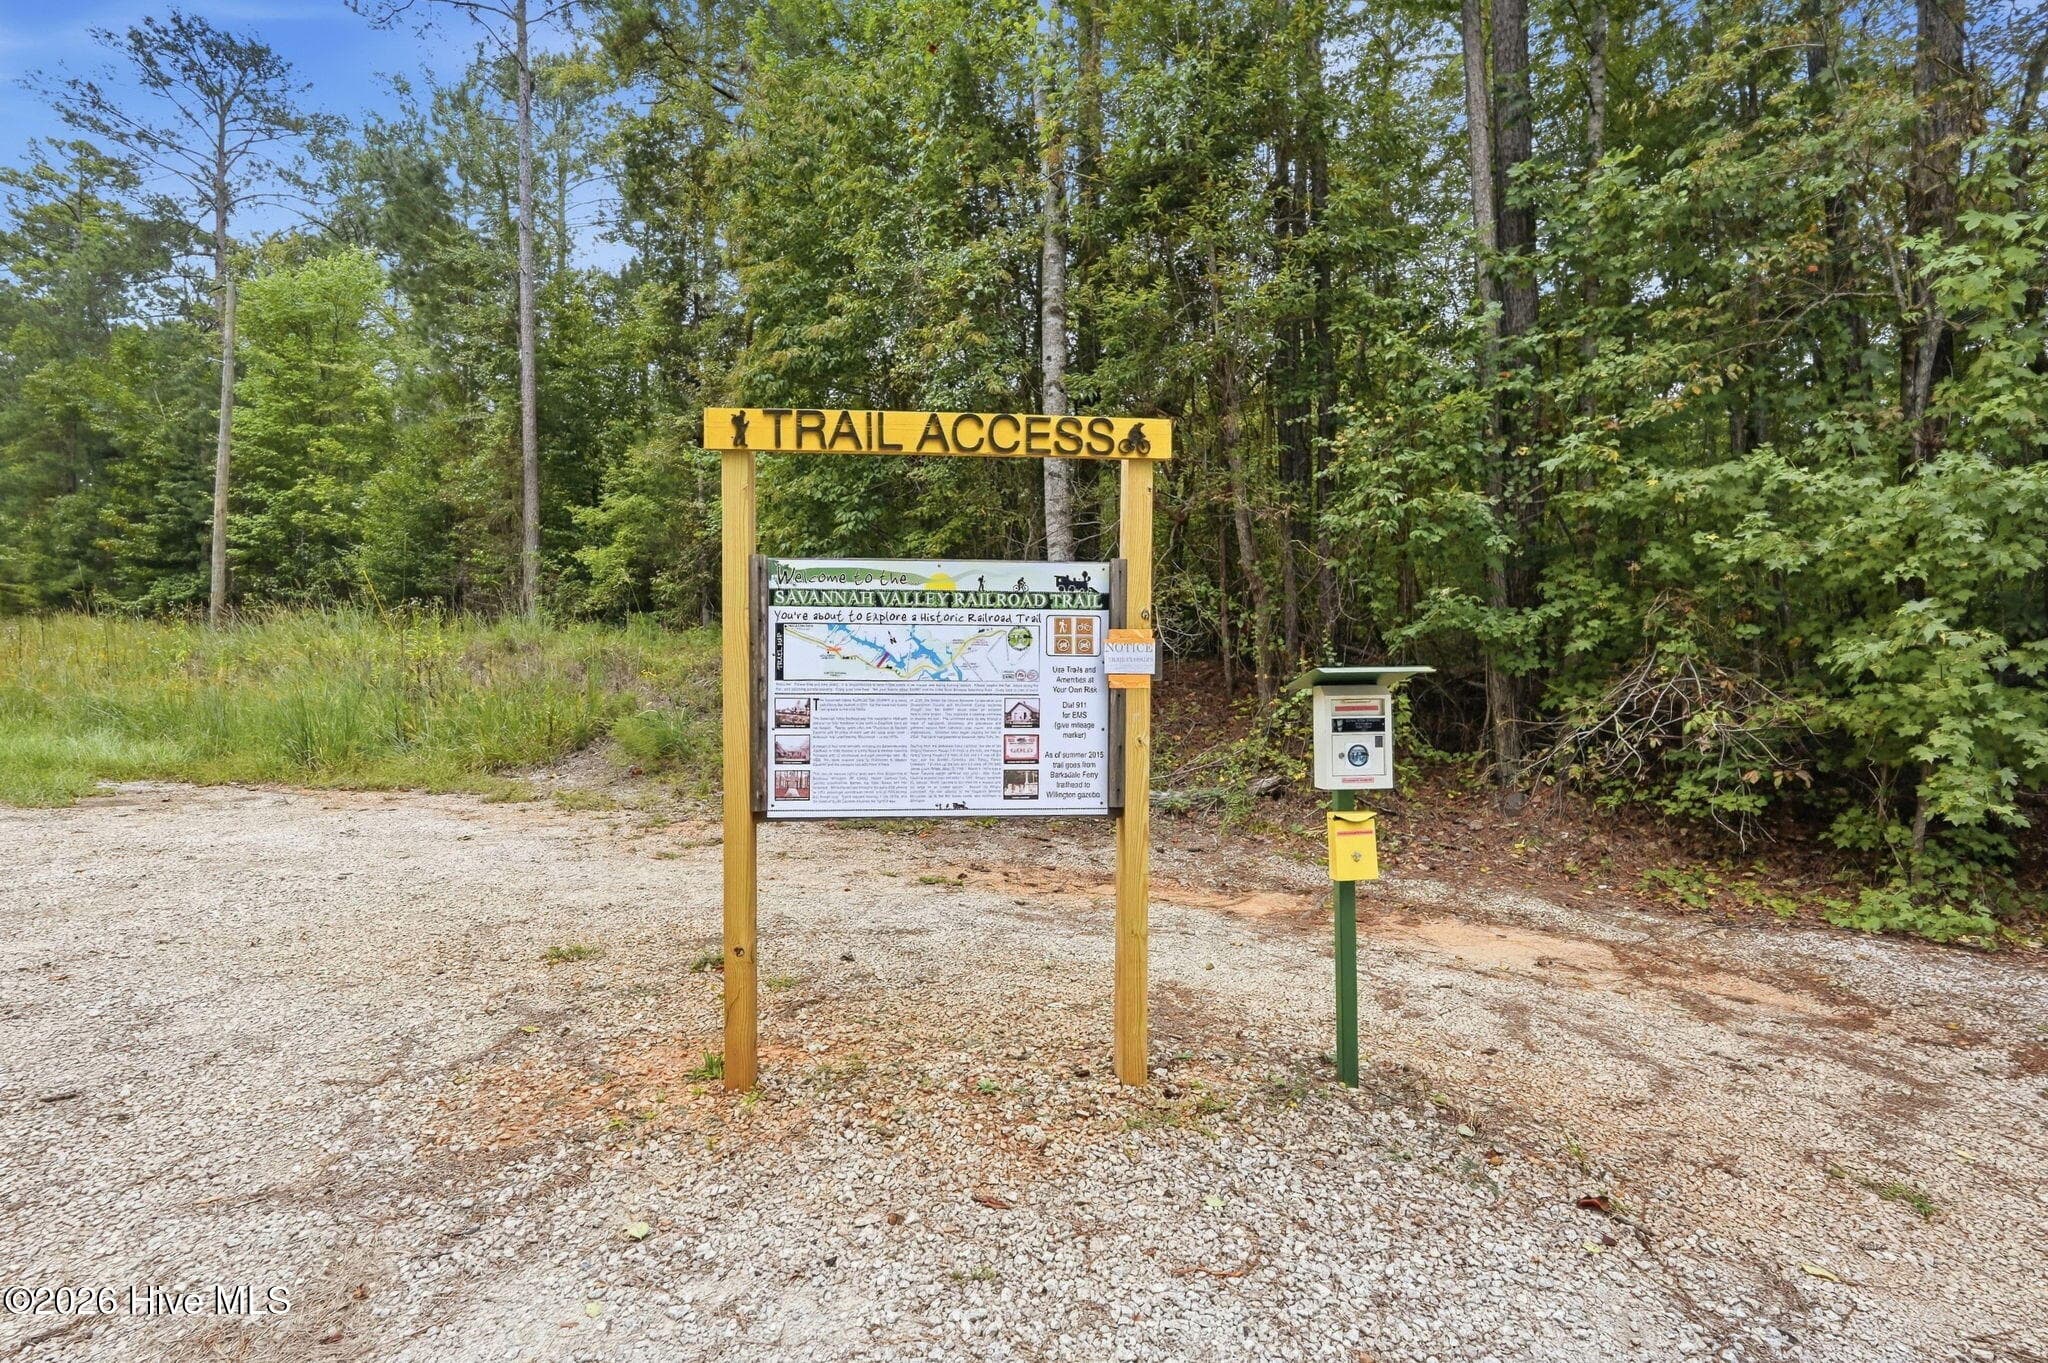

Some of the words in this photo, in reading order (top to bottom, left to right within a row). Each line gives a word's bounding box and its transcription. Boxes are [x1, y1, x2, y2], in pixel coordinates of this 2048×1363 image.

[763, 408, 903, 451] TRAIL
[916, 412, 1115, 456] ACCESS
[777, 563, 847, 585] Welcome
[854, 569, 873, 586] to
[879, 569, 908, 586] the
[774, 590, 875, 605] SAVANNAH
[878, 591, 949, 607] VALLEY
[953, 592, 1047, 608] RAILROAD
[1051, 593, 1103, 609] TRAIL
[774, 610, 808, 622] You're
[813, 610, 844, 622] about
[848, 610, 863, 622] to
[866, 611, 907, 624] Explore
[911, 613, 917, 621] a
[920, 611, 964, 623] Historic
[968, 613, 1012, 623] Railroad
[1016, 613, 1042, 624] Trail
[1104, 642, 1153, 653] NOTICE
[1062, 701, 1074, 709] Dial
[1075, 701, 1087, 709] 911
[1054, 721, 1069, 730] (give
[1070, 721, 1095, 730] mileage
[1062, 731, 1087, 740] marker)
[1044, 751, 1053, 759] As
[1054, 751, 1061, 759] of
[1065, 762, 1080, 770] goes
